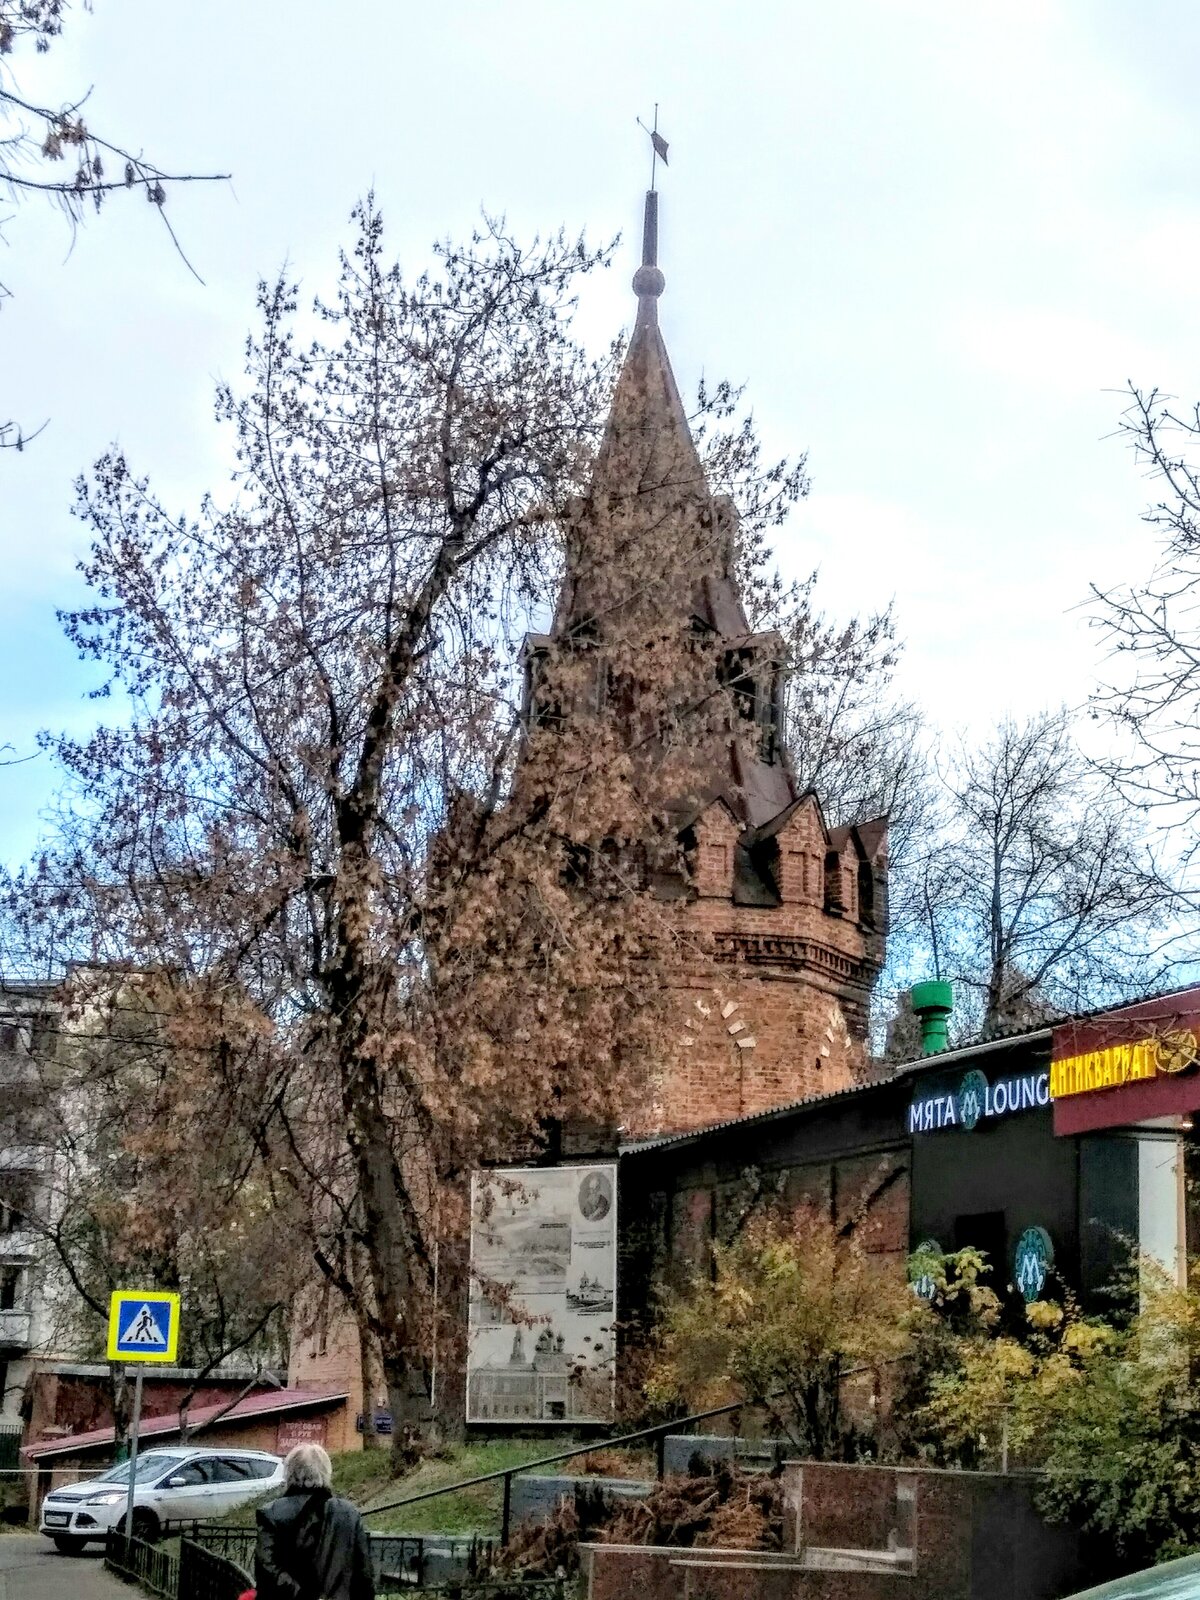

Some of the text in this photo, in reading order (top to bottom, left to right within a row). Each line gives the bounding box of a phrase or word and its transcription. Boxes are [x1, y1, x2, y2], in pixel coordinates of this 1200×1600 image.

[1050, 1039, 1157, 1098] АНТИКВАРИАТ
[910, 1096, 956, 1133] МЯТА
[985, 1073, 1054, 1117] LOUNG
